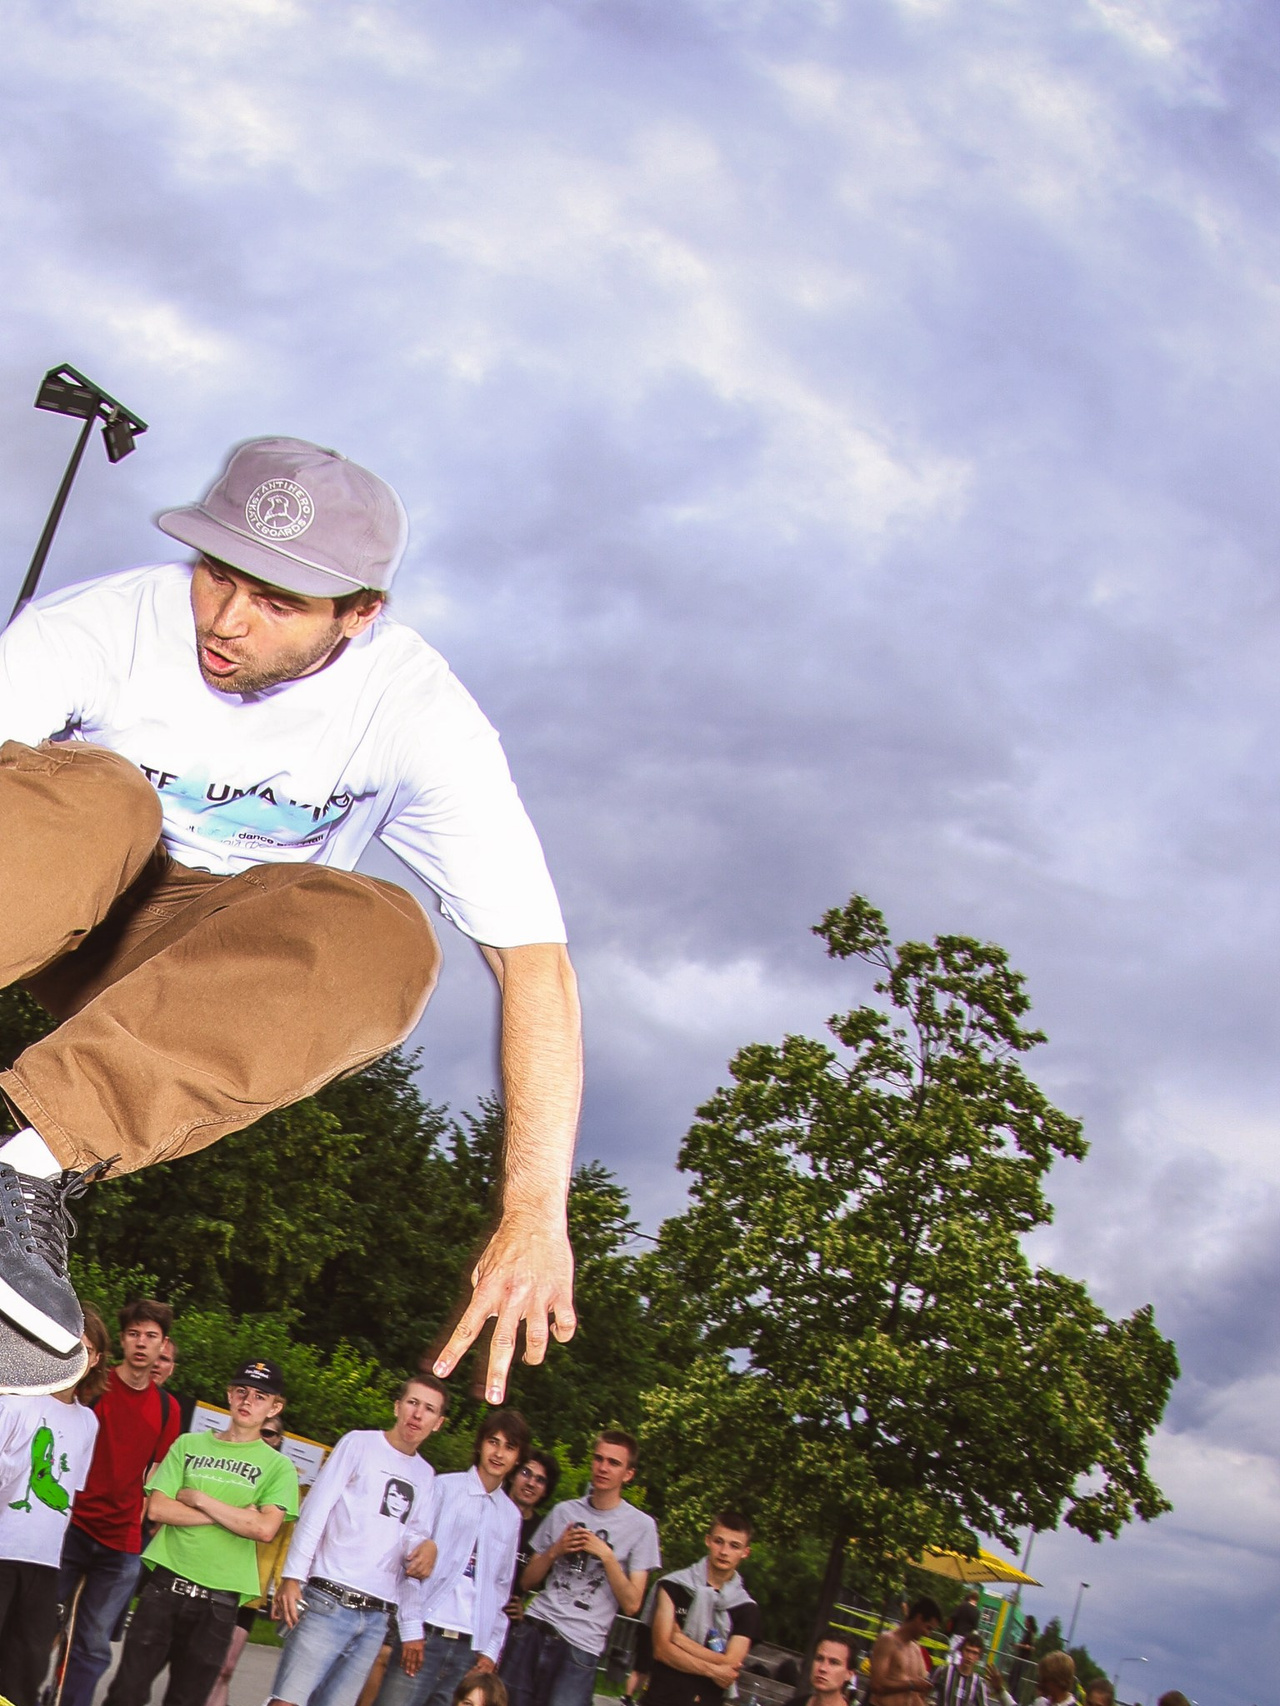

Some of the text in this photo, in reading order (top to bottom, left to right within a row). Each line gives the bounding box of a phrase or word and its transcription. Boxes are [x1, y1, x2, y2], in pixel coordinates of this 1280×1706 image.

[261, 481, 311, 514] ANTIHERO
[248, 496, 307, 538] SKATEBOARDS
[238, 832, 274, 845] dance
[184, 1453, 262, 1485] THRASHER
